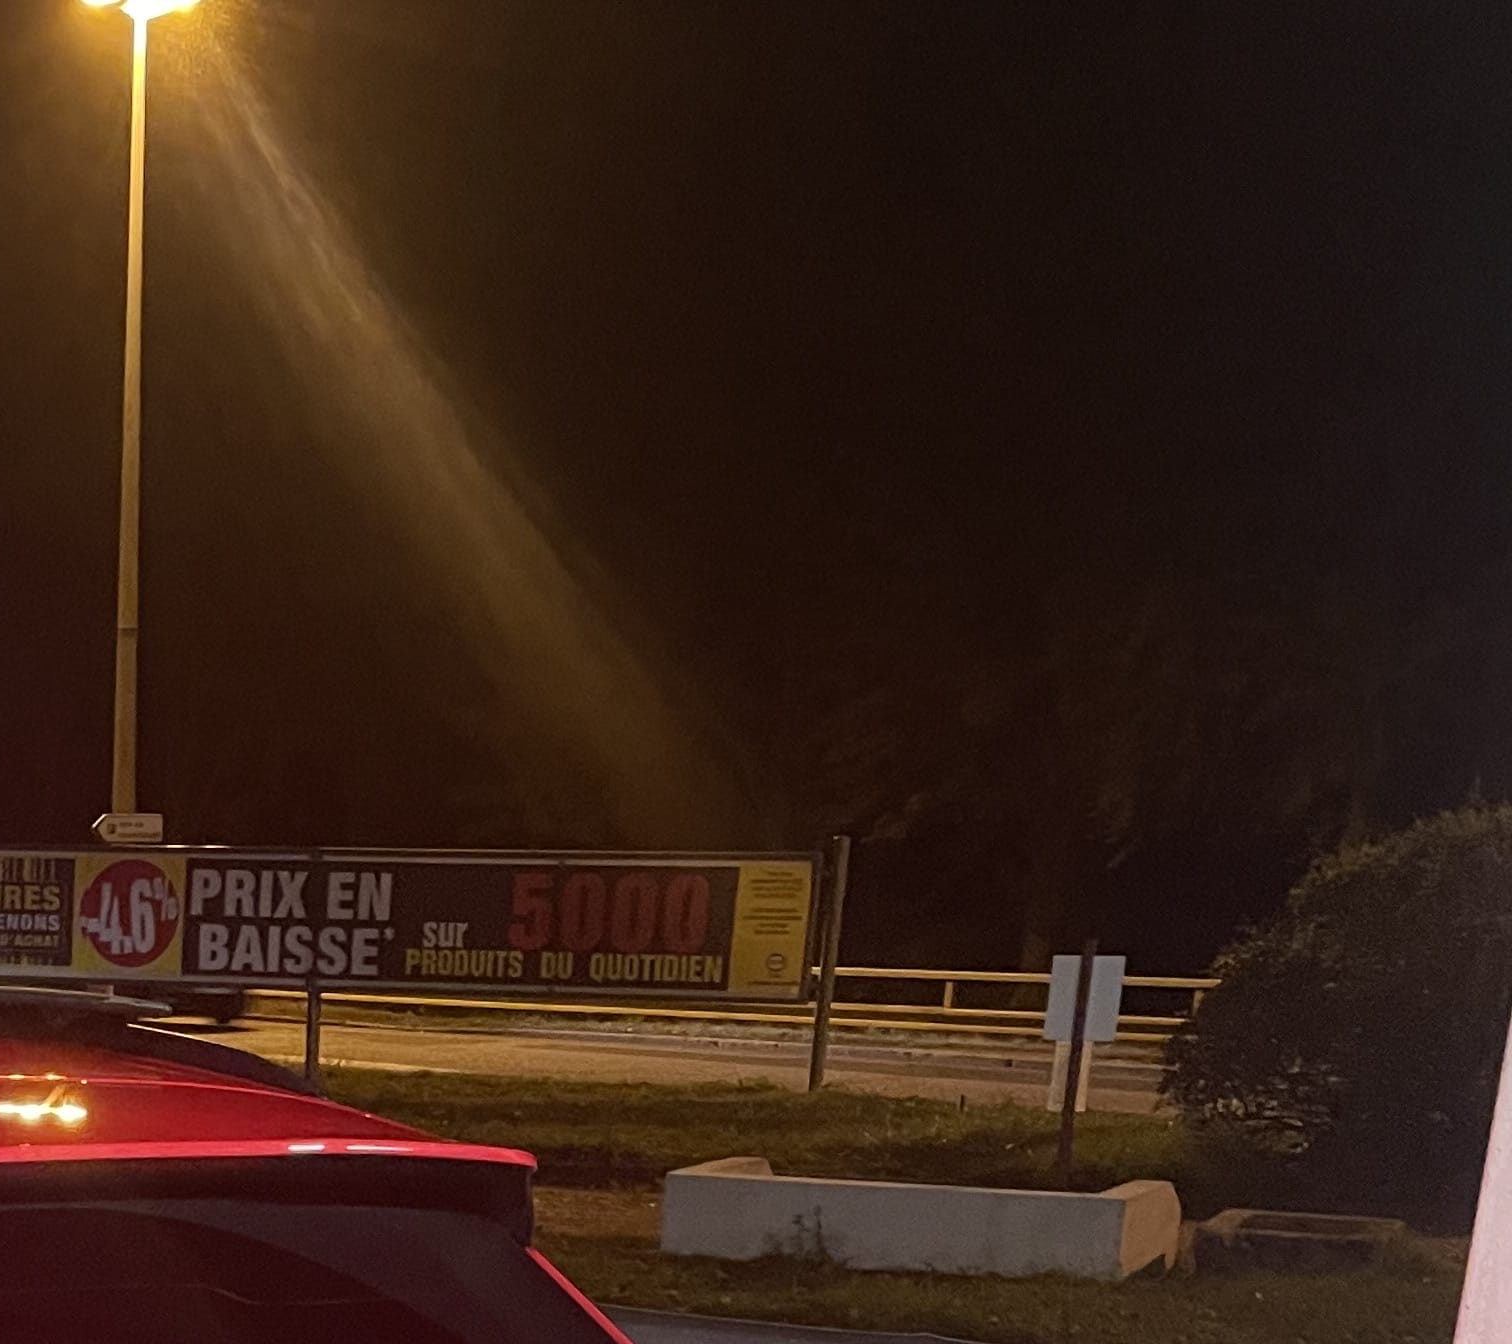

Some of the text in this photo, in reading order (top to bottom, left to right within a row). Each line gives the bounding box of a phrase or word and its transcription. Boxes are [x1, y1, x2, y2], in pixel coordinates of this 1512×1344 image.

[190, 868, 393, 921] PRIX EN
[508, 872, 711, 952] 5000
[404, 948, 723, 984] PRODUITS DU QUOTIDIEN
